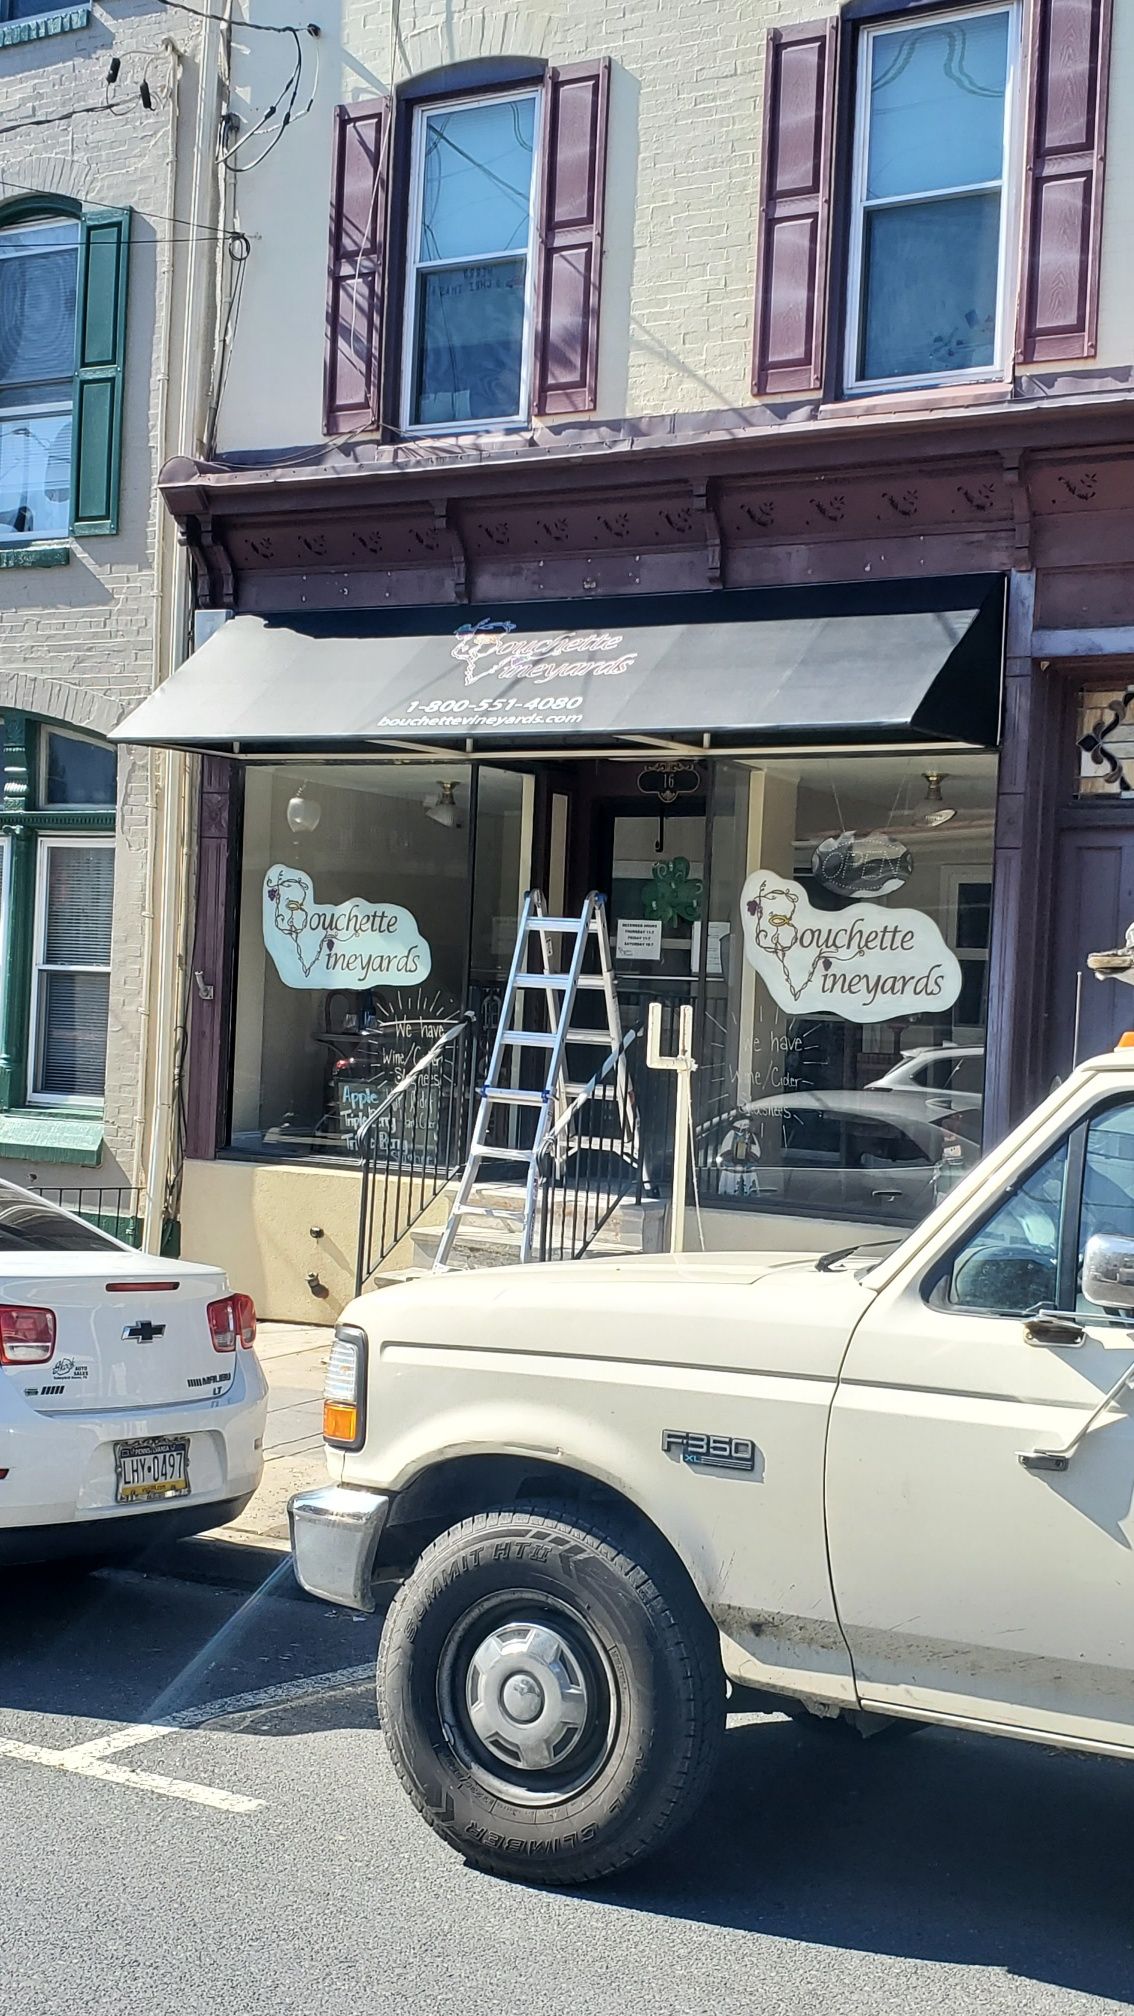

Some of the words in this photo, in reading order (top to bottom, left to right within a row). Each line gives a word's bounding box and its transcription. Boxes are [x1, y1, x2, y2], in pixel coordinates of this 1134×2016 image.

[451, 617, 624, 660] Bouchette
[464, 652, 638, 687] Vineyards
[406, 696, 583, 714] 1-800-551-4080
[377, 711, 583, 729] bouchettevineyards.com
[663, 773, 675, 789] 16
[822, 850, 902, 880] OPEN
[266, 870, 399, 937] Bouchette
[753, 880, 915, 954] Bouchette
[291, 928, 421, 982] Vineyards
[775, 944, 945, 1007] Vineyards
[395, 1014, 412, 1038] We
[420, 1015, 444, 1039] have
[770, 1030, 803, 1053] have
[342, 1085, 379, 1109] Apple
[201, 1373, 232, 1387] MALIBU
[213, 1386, 223, 1396] LT
[684, 1454, 701, 1463] XL
[404, 1545, 484, 1644] SUMMIT
[464, 1820, 600, 1857] CLIMBER
